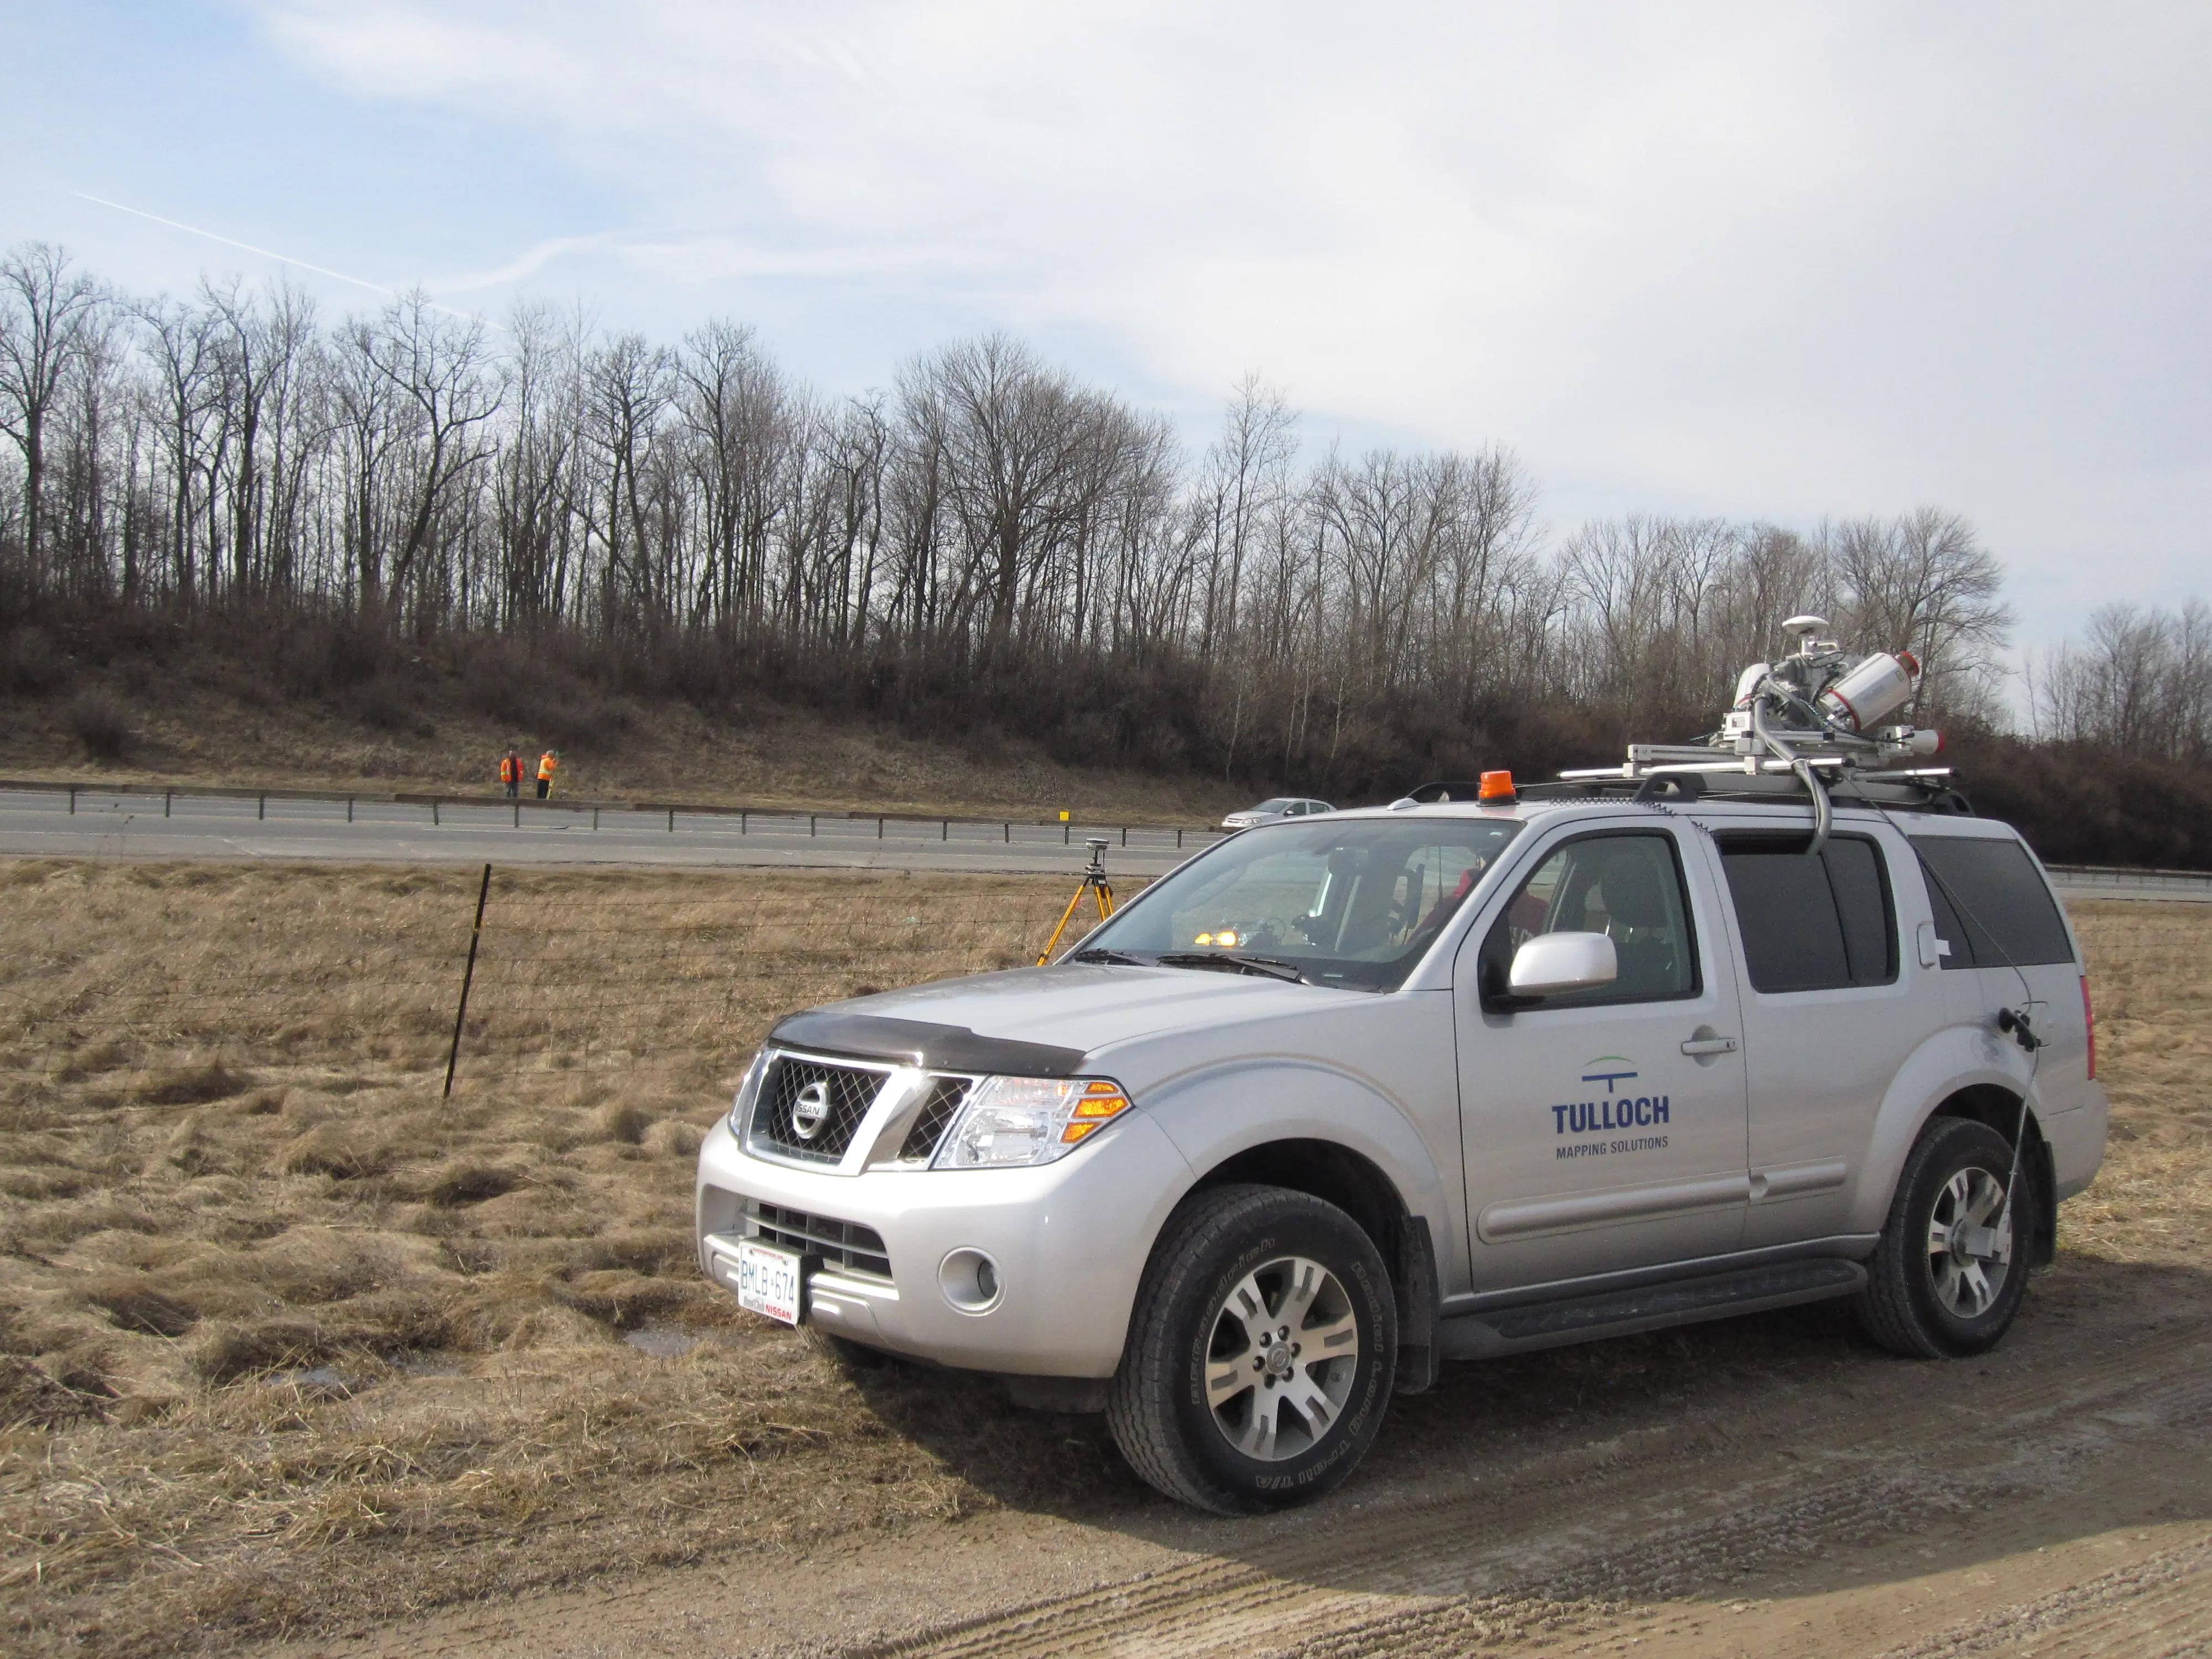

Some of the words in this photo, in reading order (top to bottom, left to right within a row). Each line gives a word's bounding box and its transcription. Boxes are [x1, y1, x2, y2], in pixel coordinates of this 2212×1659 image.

[1552, 1095, 1669, 1134] TULLOCH
[1557, 1142, 1606, 1160] MAPPING
[1611, 1136, 1668, 1154] SOLUTIONS
[742, 1260, 768, 1296] BMLB
[775, 1271, 794, 1305] 674
[766, 1304, 791, 1321] NISSAN
